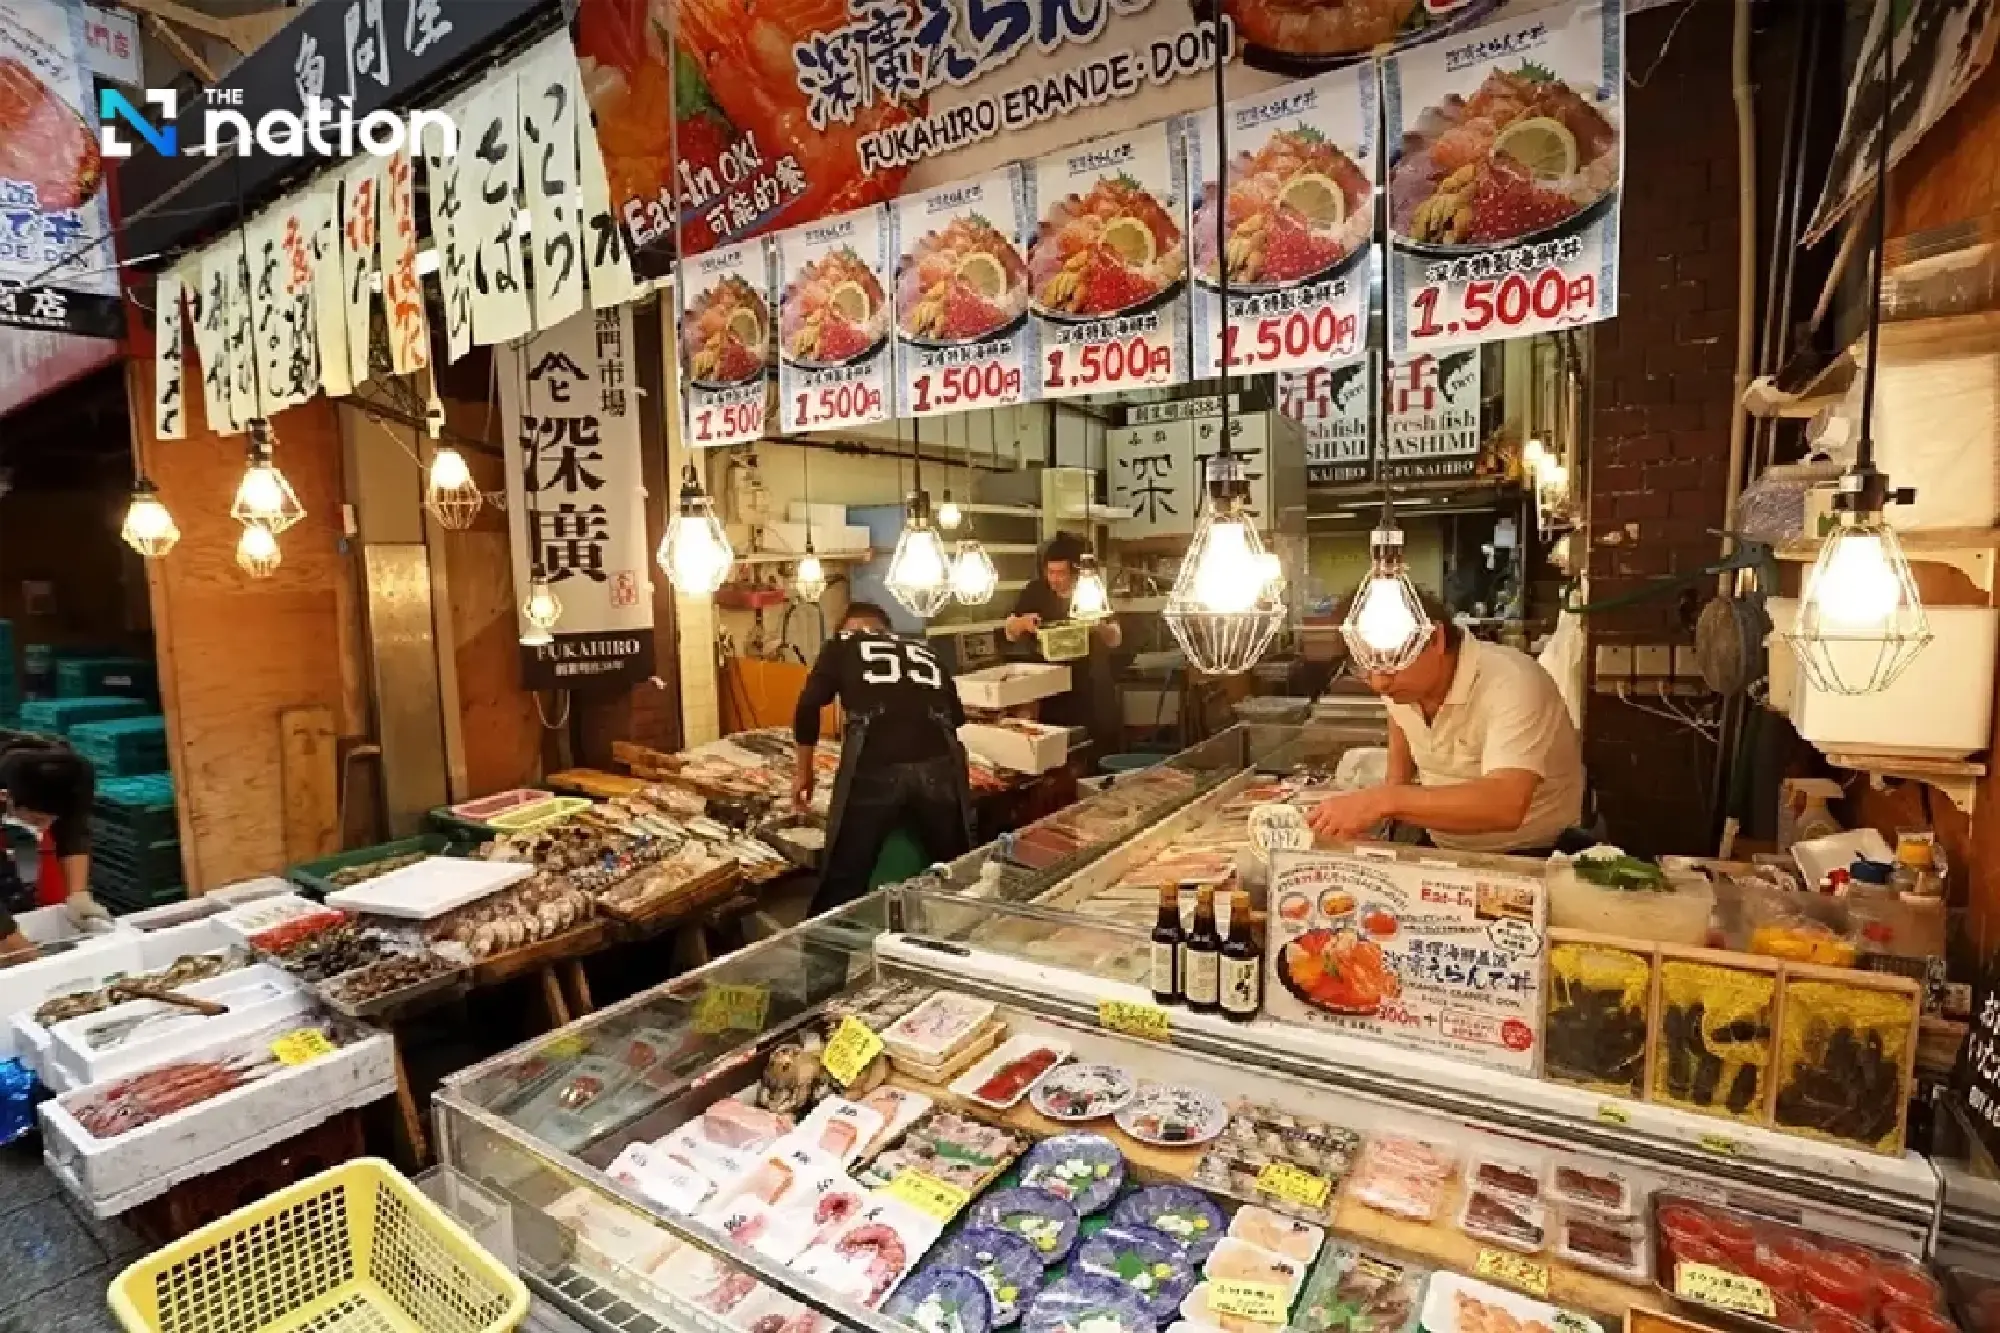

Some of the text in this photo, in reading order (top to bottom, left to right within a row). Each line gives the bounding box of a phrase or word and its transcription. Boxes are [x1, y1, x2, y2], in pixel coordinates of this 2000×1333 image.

[860, 99, 996, 170] FUKAHIRO
[623, 130, 764, 246] Eat-In OK!
[537, 639, 640, 661] FUKAHIRO
[861, 641, 941, 689] 55
[1421, 887, 1473, 908] Eat-In
